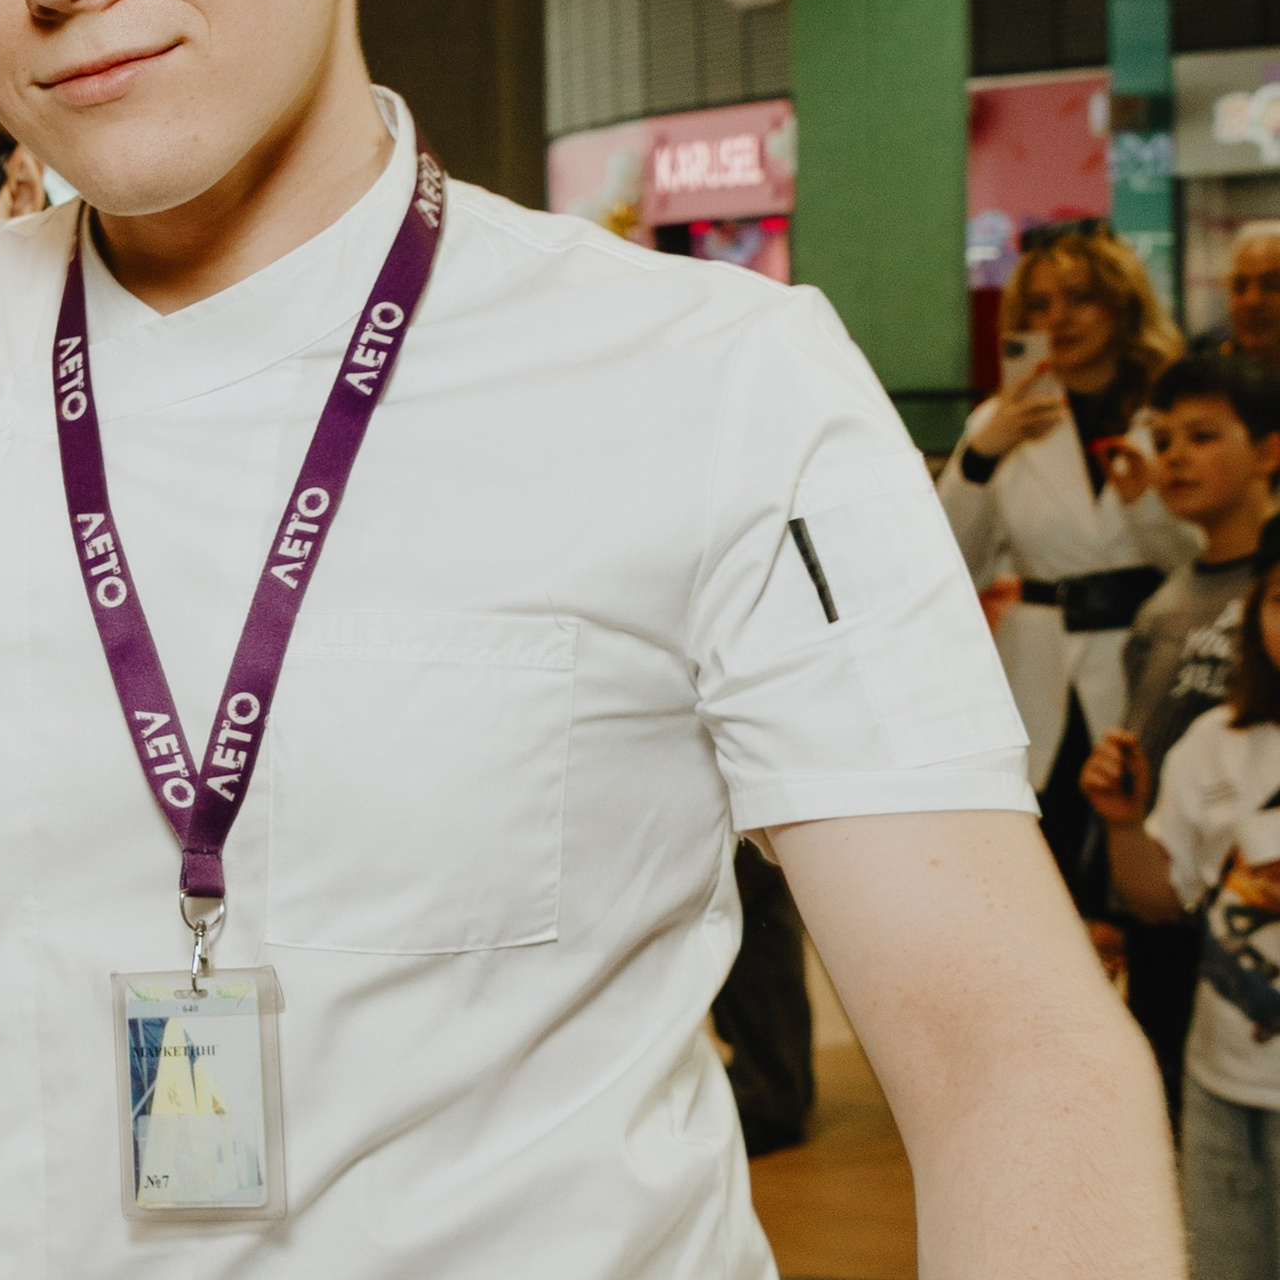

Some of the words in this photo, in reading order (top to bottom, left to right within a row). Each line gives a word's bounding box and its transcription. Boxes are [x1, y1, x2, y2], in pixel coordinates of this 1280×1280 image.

[58, 336, 88, 422] ЛЕТО
[345, 302, 405, 396] ЛЕТО
[77, 512, 128, 609] ЛЕТО
[270, 487, 331, 589] ЛЕТО
[134, 711, 196, 809] ЛЕТО
[206, 691, 261, 802] ЛЕТО
[133, 1044, 220, 1058] МАРКЕТИНГ
